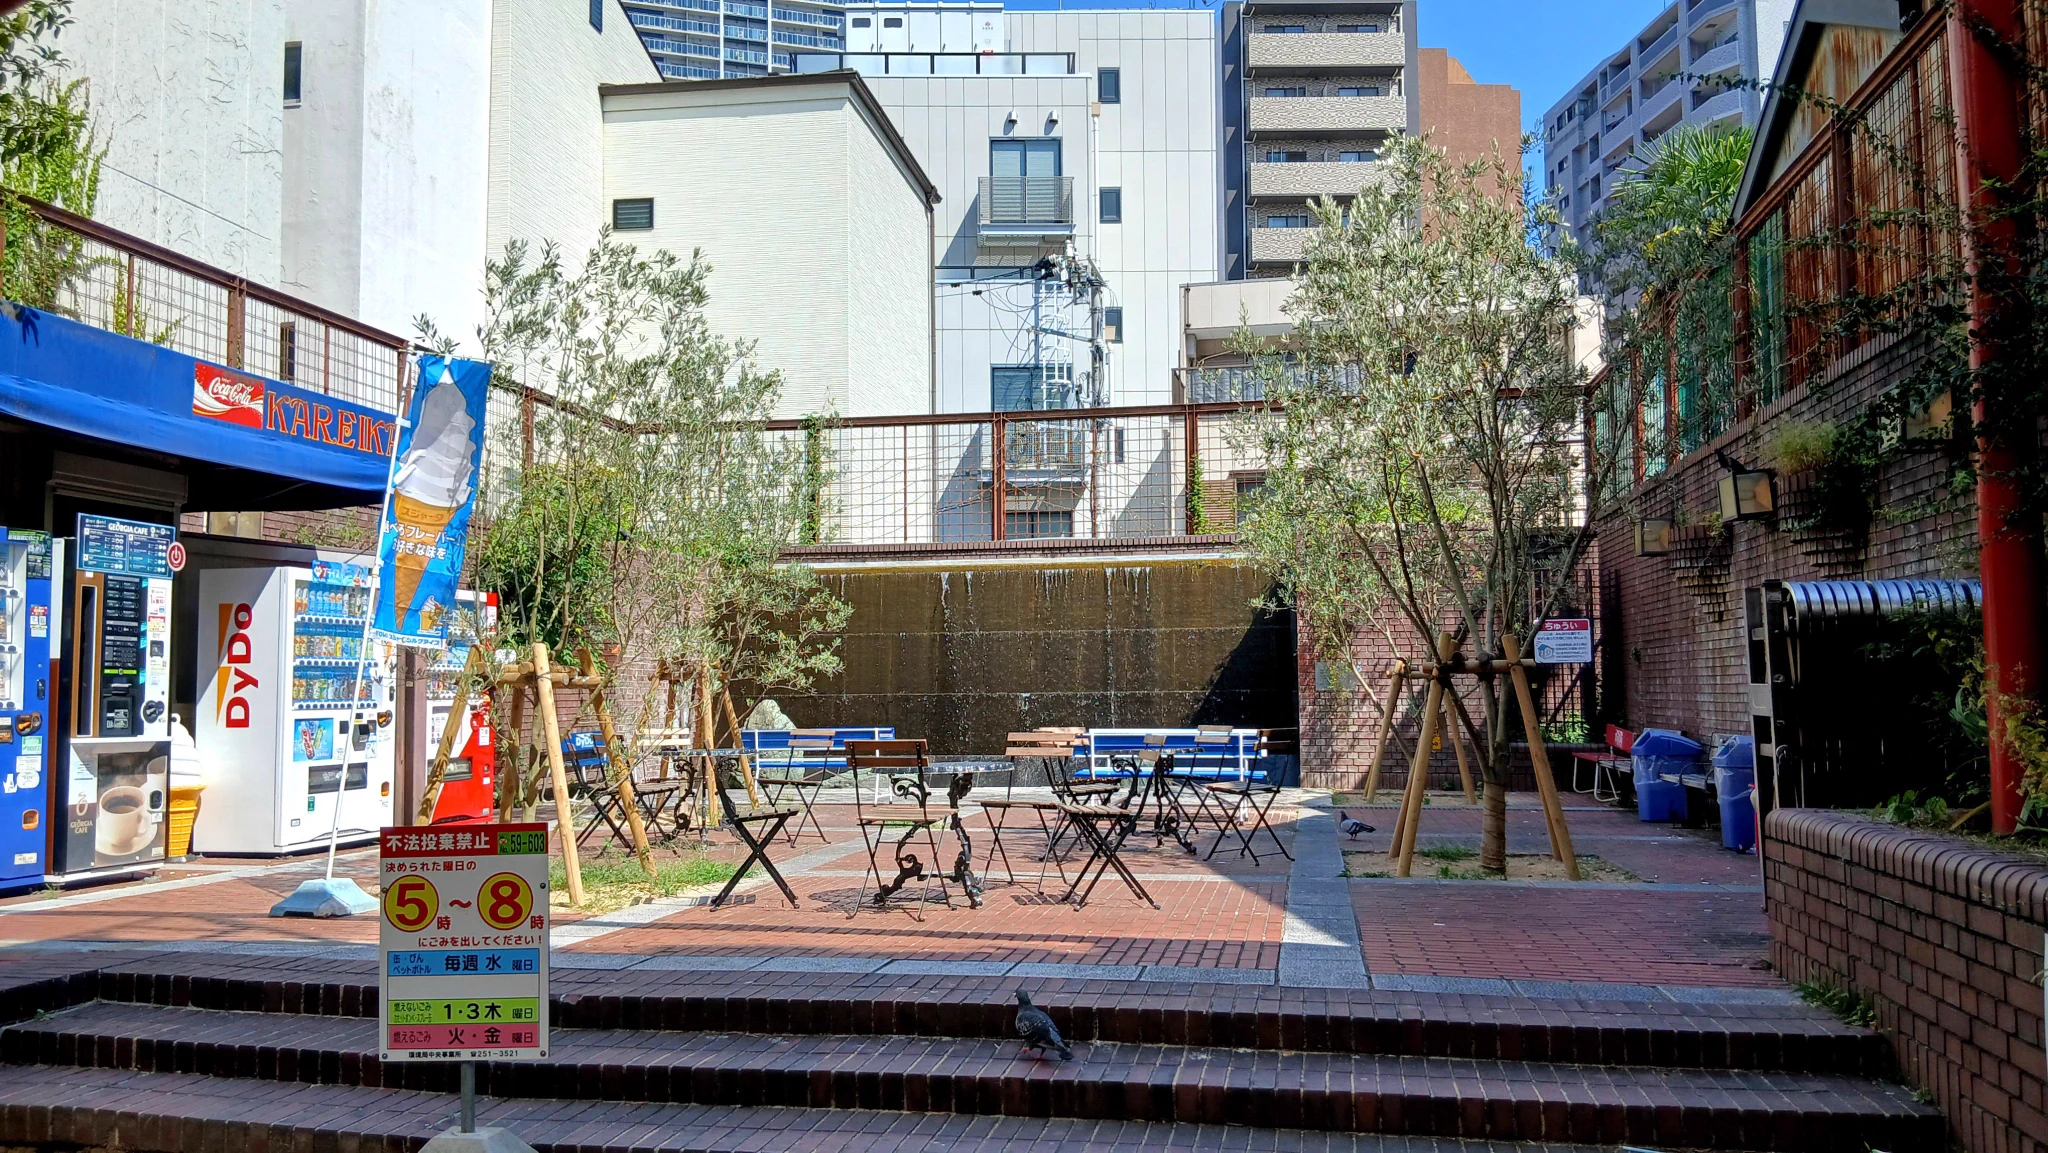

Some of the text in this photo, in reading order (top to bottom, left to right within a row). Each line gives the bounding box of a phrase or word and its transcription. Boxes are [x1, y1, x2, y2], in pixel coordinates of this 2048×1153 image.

[209, 377, 254, 406] Coca-Cola
[133, 526, 149, 535] CAFE
[1545, 622, 1578, 631] ちゅうい
[226, 603, 259, 728] DyDo
[386, 832, 491, 852] 不法投棄禁止
[510, 834, 545, 853] 59-603
[385, 860, 477, 873] 決められた曜日の
[393, 965, 432, 975] ペットボトル
[393, 1002, 432, 1012] 燃えないごみ
[393, 1030, 432, 1044] 燃えるごみ
